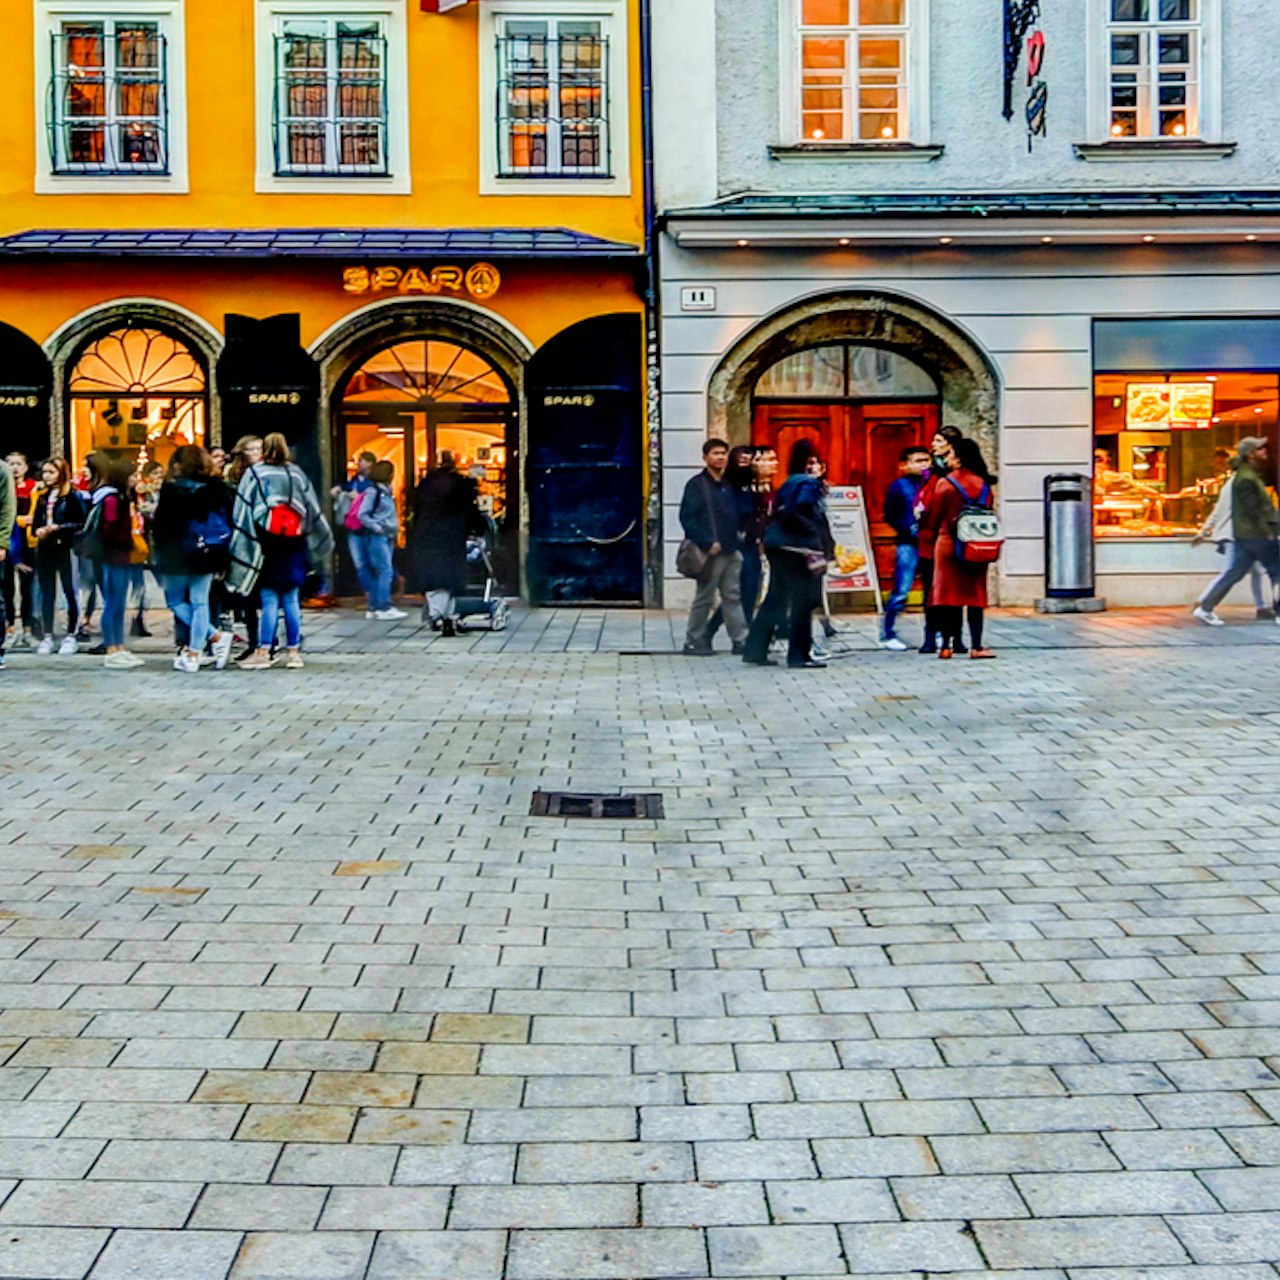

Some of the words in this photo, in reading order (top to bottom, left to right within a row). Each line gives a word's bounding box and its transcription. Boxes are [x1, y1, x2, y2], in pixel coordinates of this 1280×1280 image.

[342, 265, 464, 294] SPAR
[691, 290, 705, 302] 11
[248, 393, 288, 404] SPAR
[543, 395, 583, 407] SPAR
